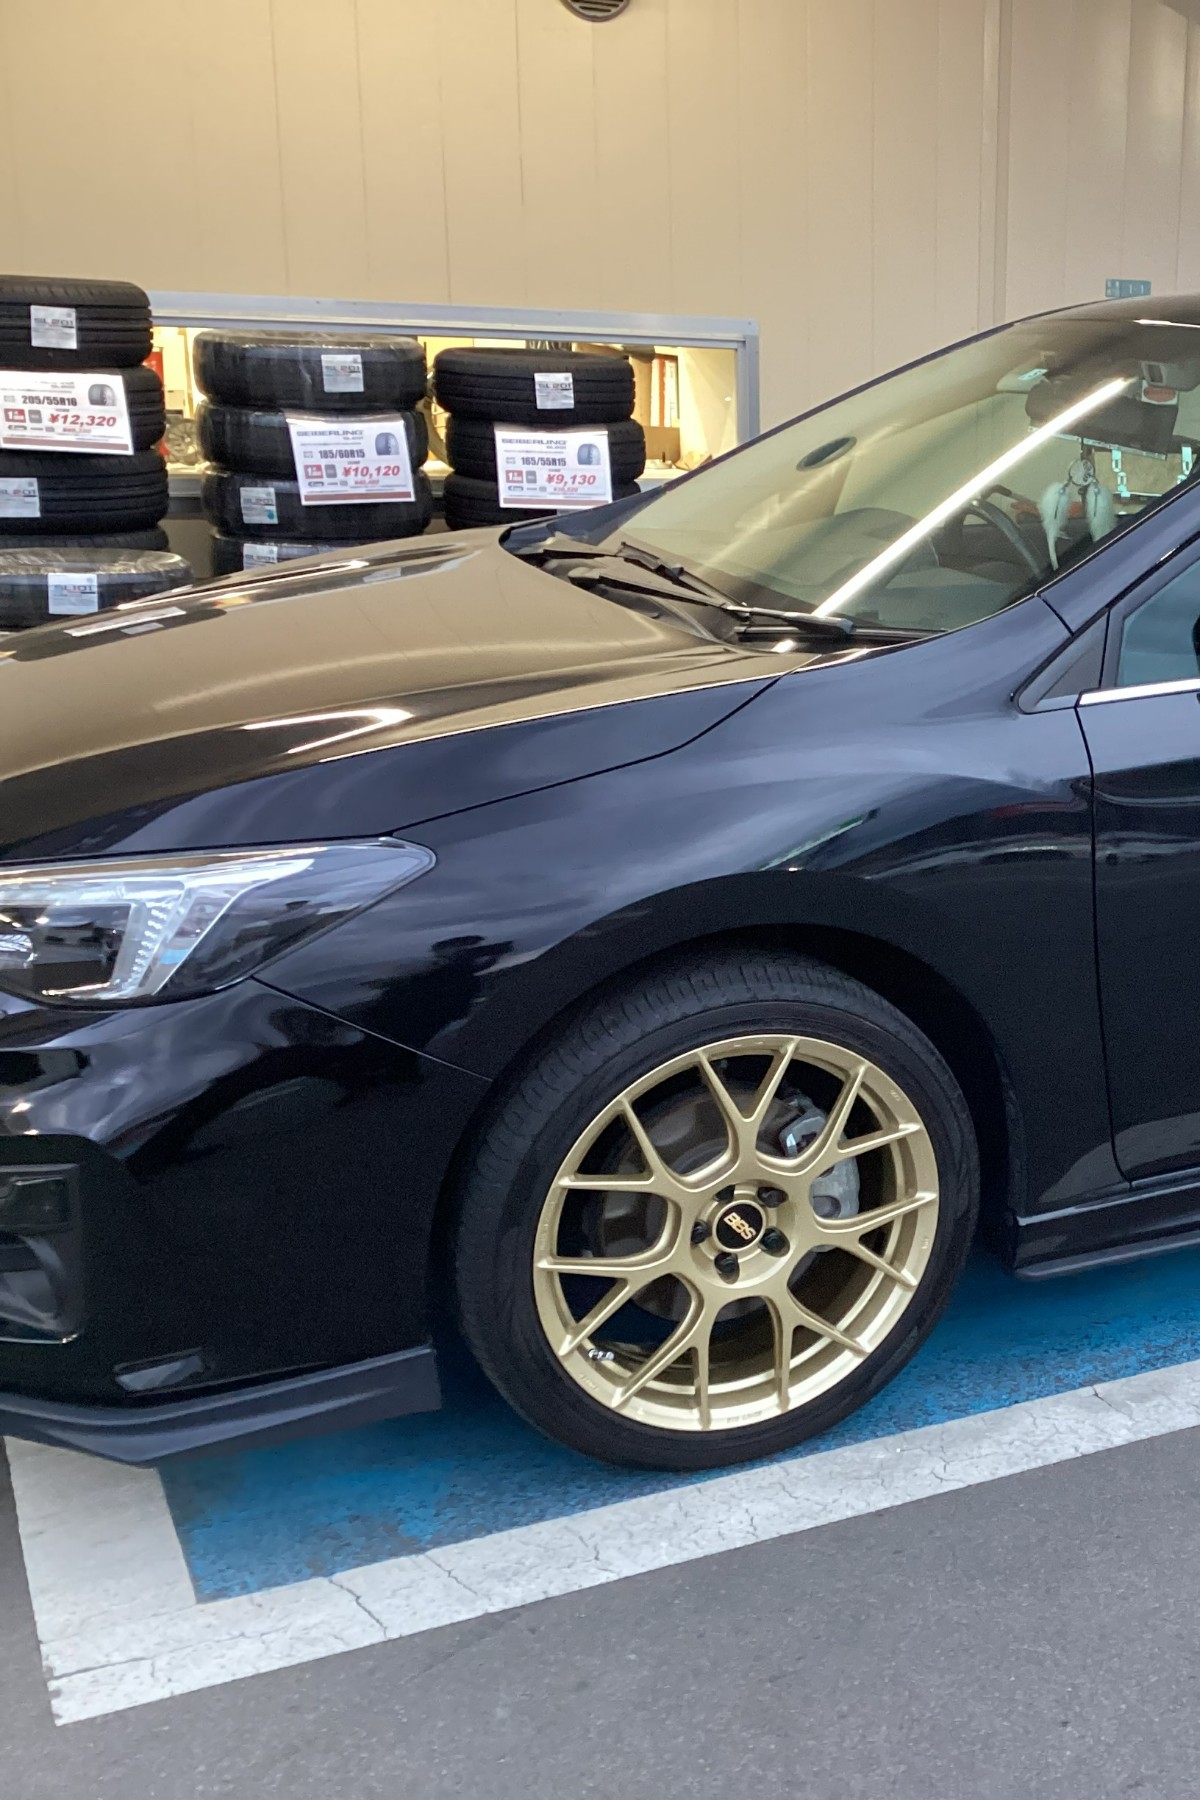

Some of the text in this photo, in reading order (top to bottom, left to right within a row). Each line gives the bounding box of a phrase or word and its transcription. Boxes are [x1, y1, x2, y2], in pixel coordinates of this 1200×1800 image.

[21, 395, 78, 406] 205/55R16
[48, 413, 117, 427] ¥12,320
[296, 429, 364, 437] SEIBERLING
[318, 449, 366, 459] 185/60R15
[521, 456, 567, 467] 165/55R15
[342, 465, 400, 479] ¥10,120
[546, 474, 596, 487] ¥9,130
[723, 1212, 757, 1240] BBS
